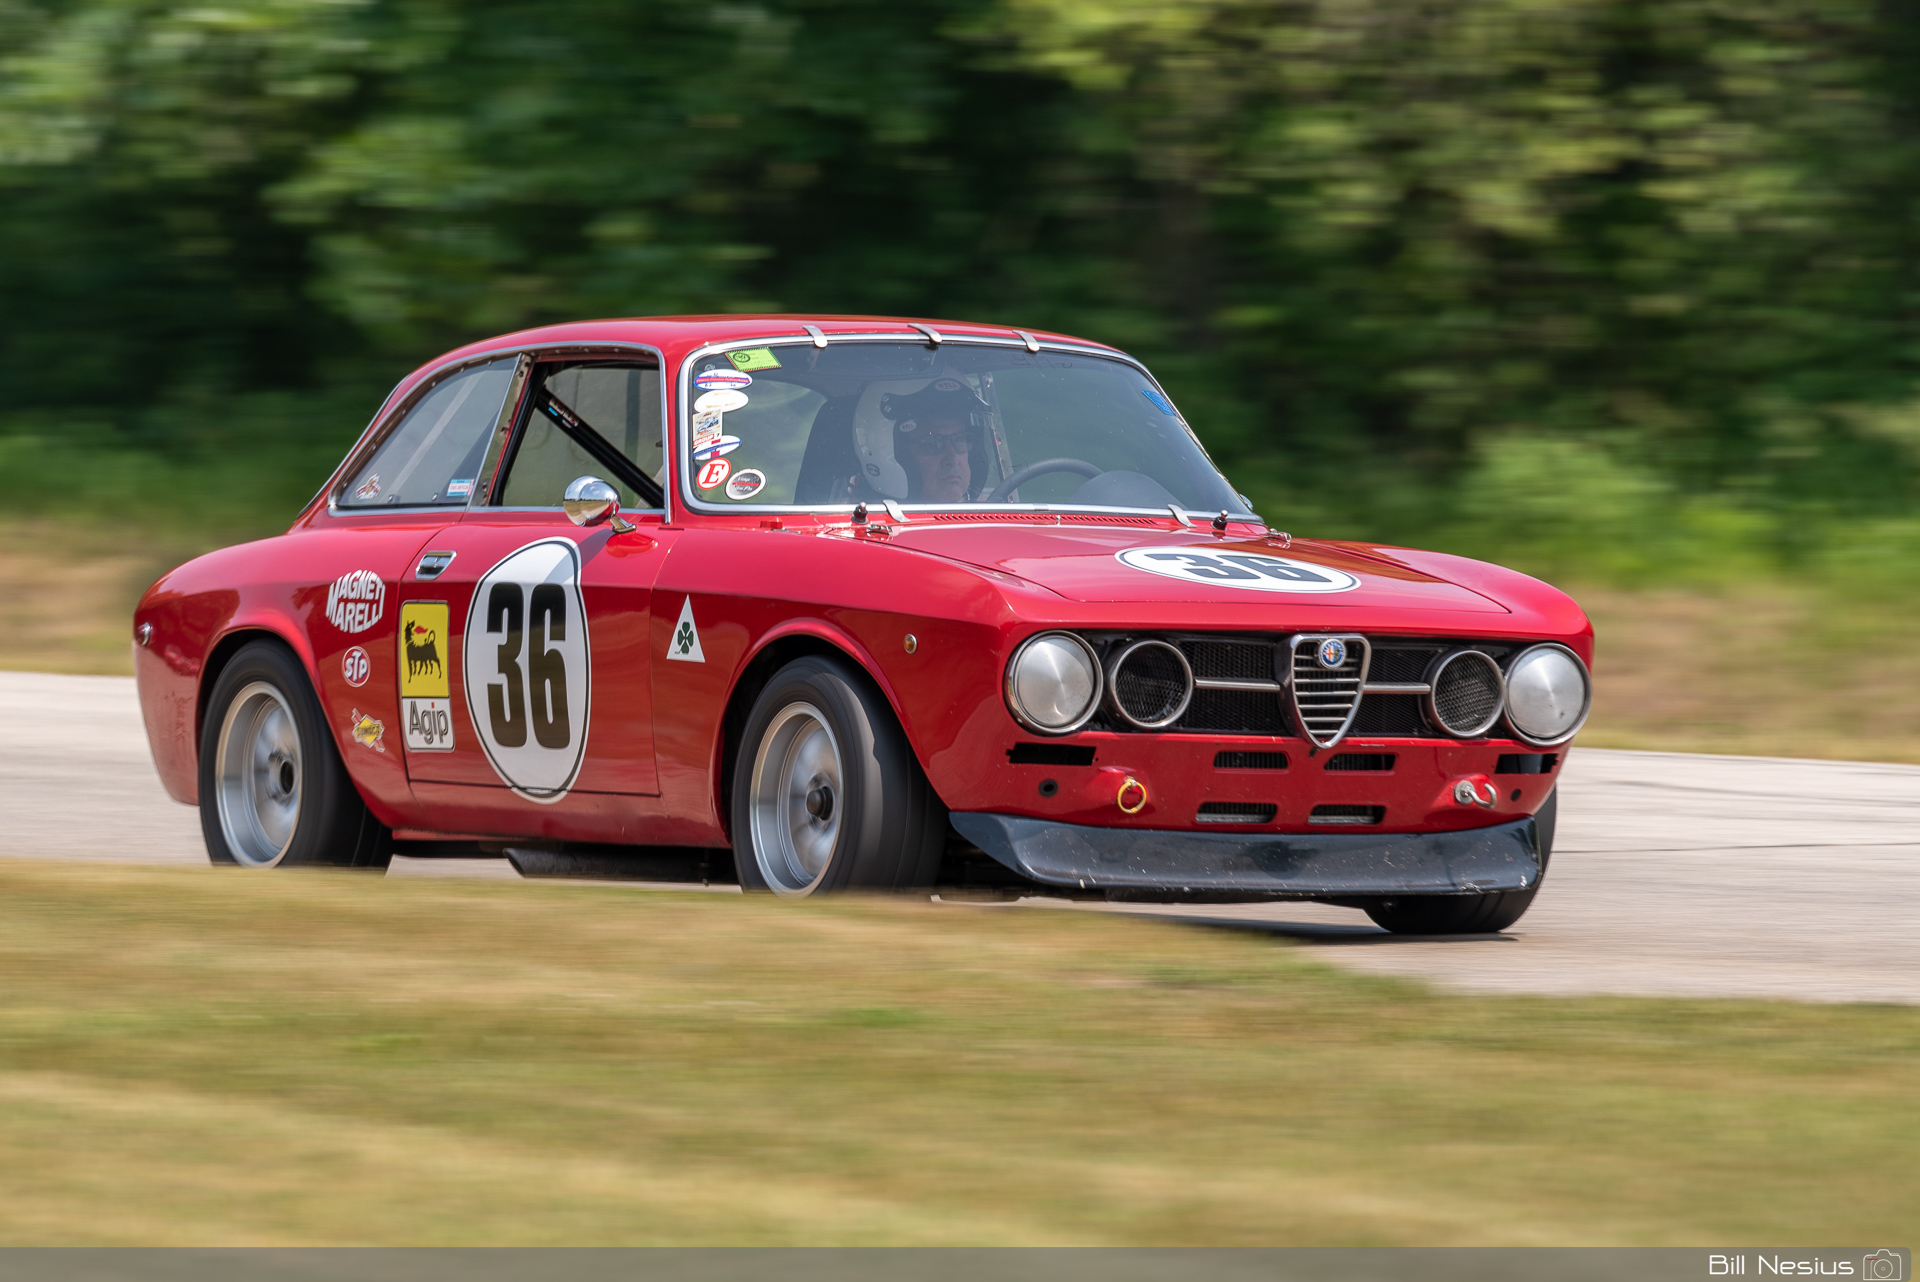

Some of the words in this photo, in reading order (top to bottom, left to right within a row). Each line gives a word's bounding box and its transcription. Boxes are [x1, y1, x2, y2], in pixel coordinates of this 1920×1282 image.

[693, 434, 714, 447] GROUP
[702, 463, 725, 485] E
[1143, 553, 1333, 583] 36
[326, 569, 386, 600] MAGNETI
[325, 601, 385, 634] MARELLI
[344, 651, 368, 683] STP
[486, 582, 571, 749] 36
[409, 700, 449, 745] Agip
